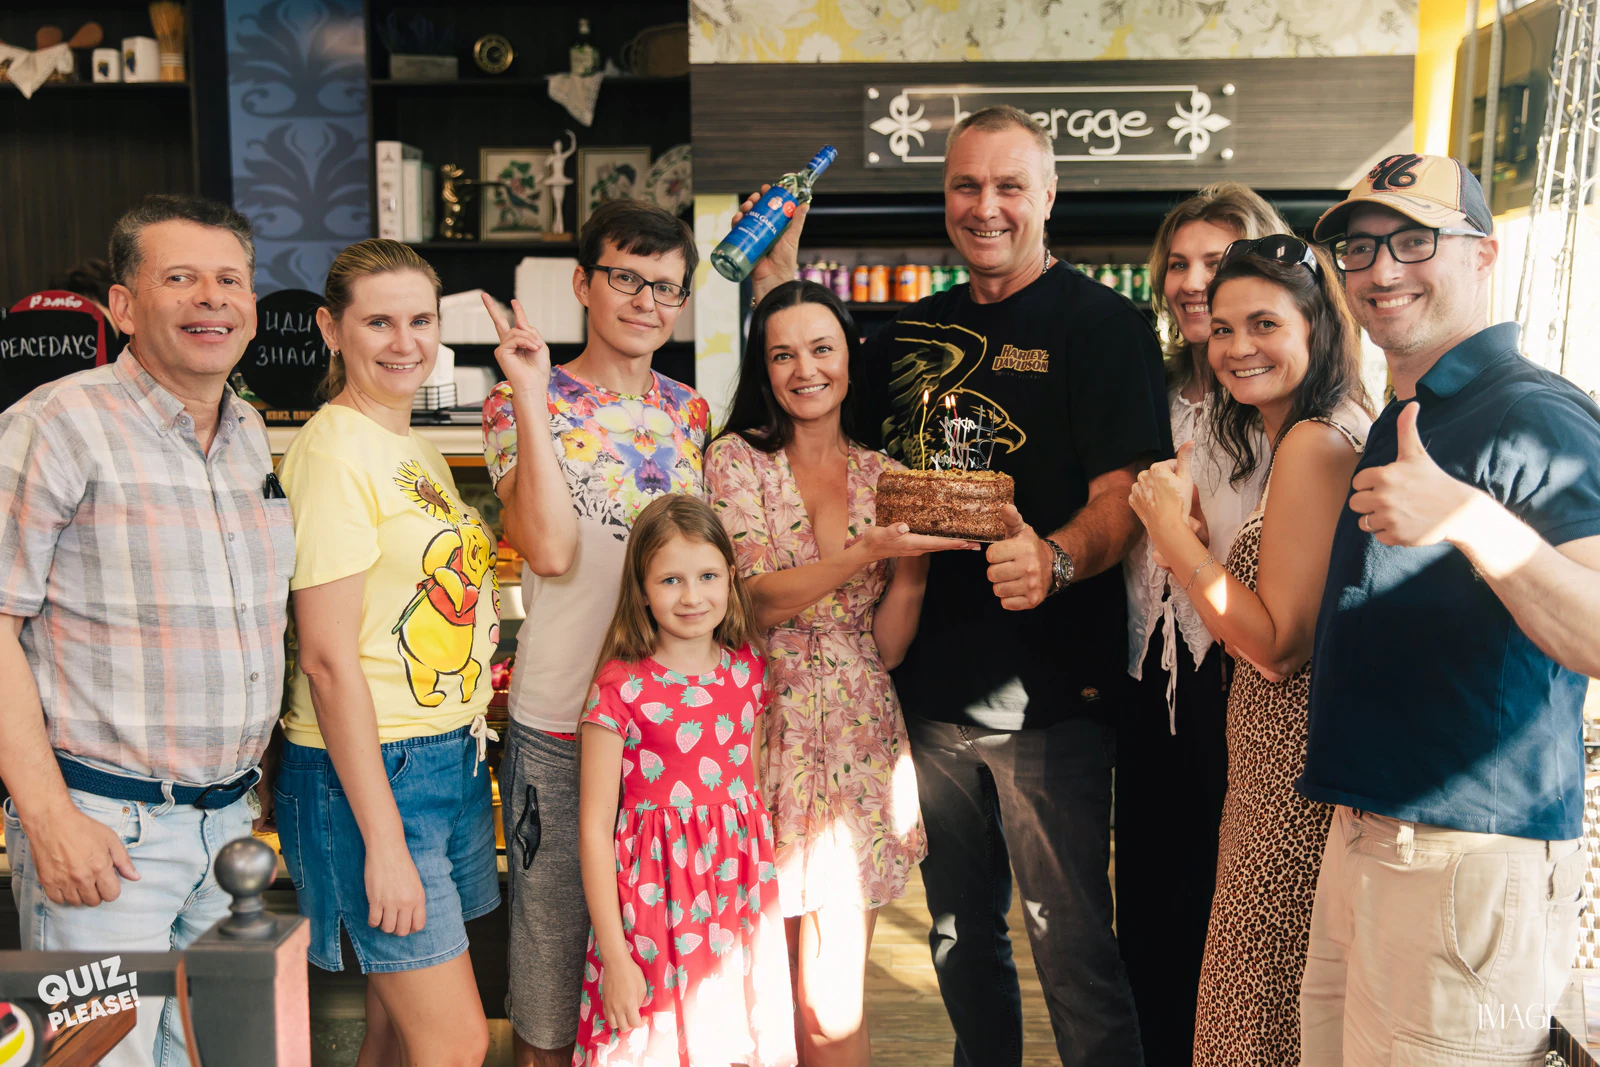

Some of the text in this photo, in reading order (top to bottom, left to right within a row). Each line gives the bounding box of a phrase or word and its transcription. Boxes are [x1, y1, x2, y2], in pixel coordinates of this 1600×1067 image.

[953, 94, 1154, 156] berage
[265, 310, 312, 336] ИДИ
[0, 334, 97, 360] PEACEDAYS
[992, 356, 1049, 373] DAVIDSON
